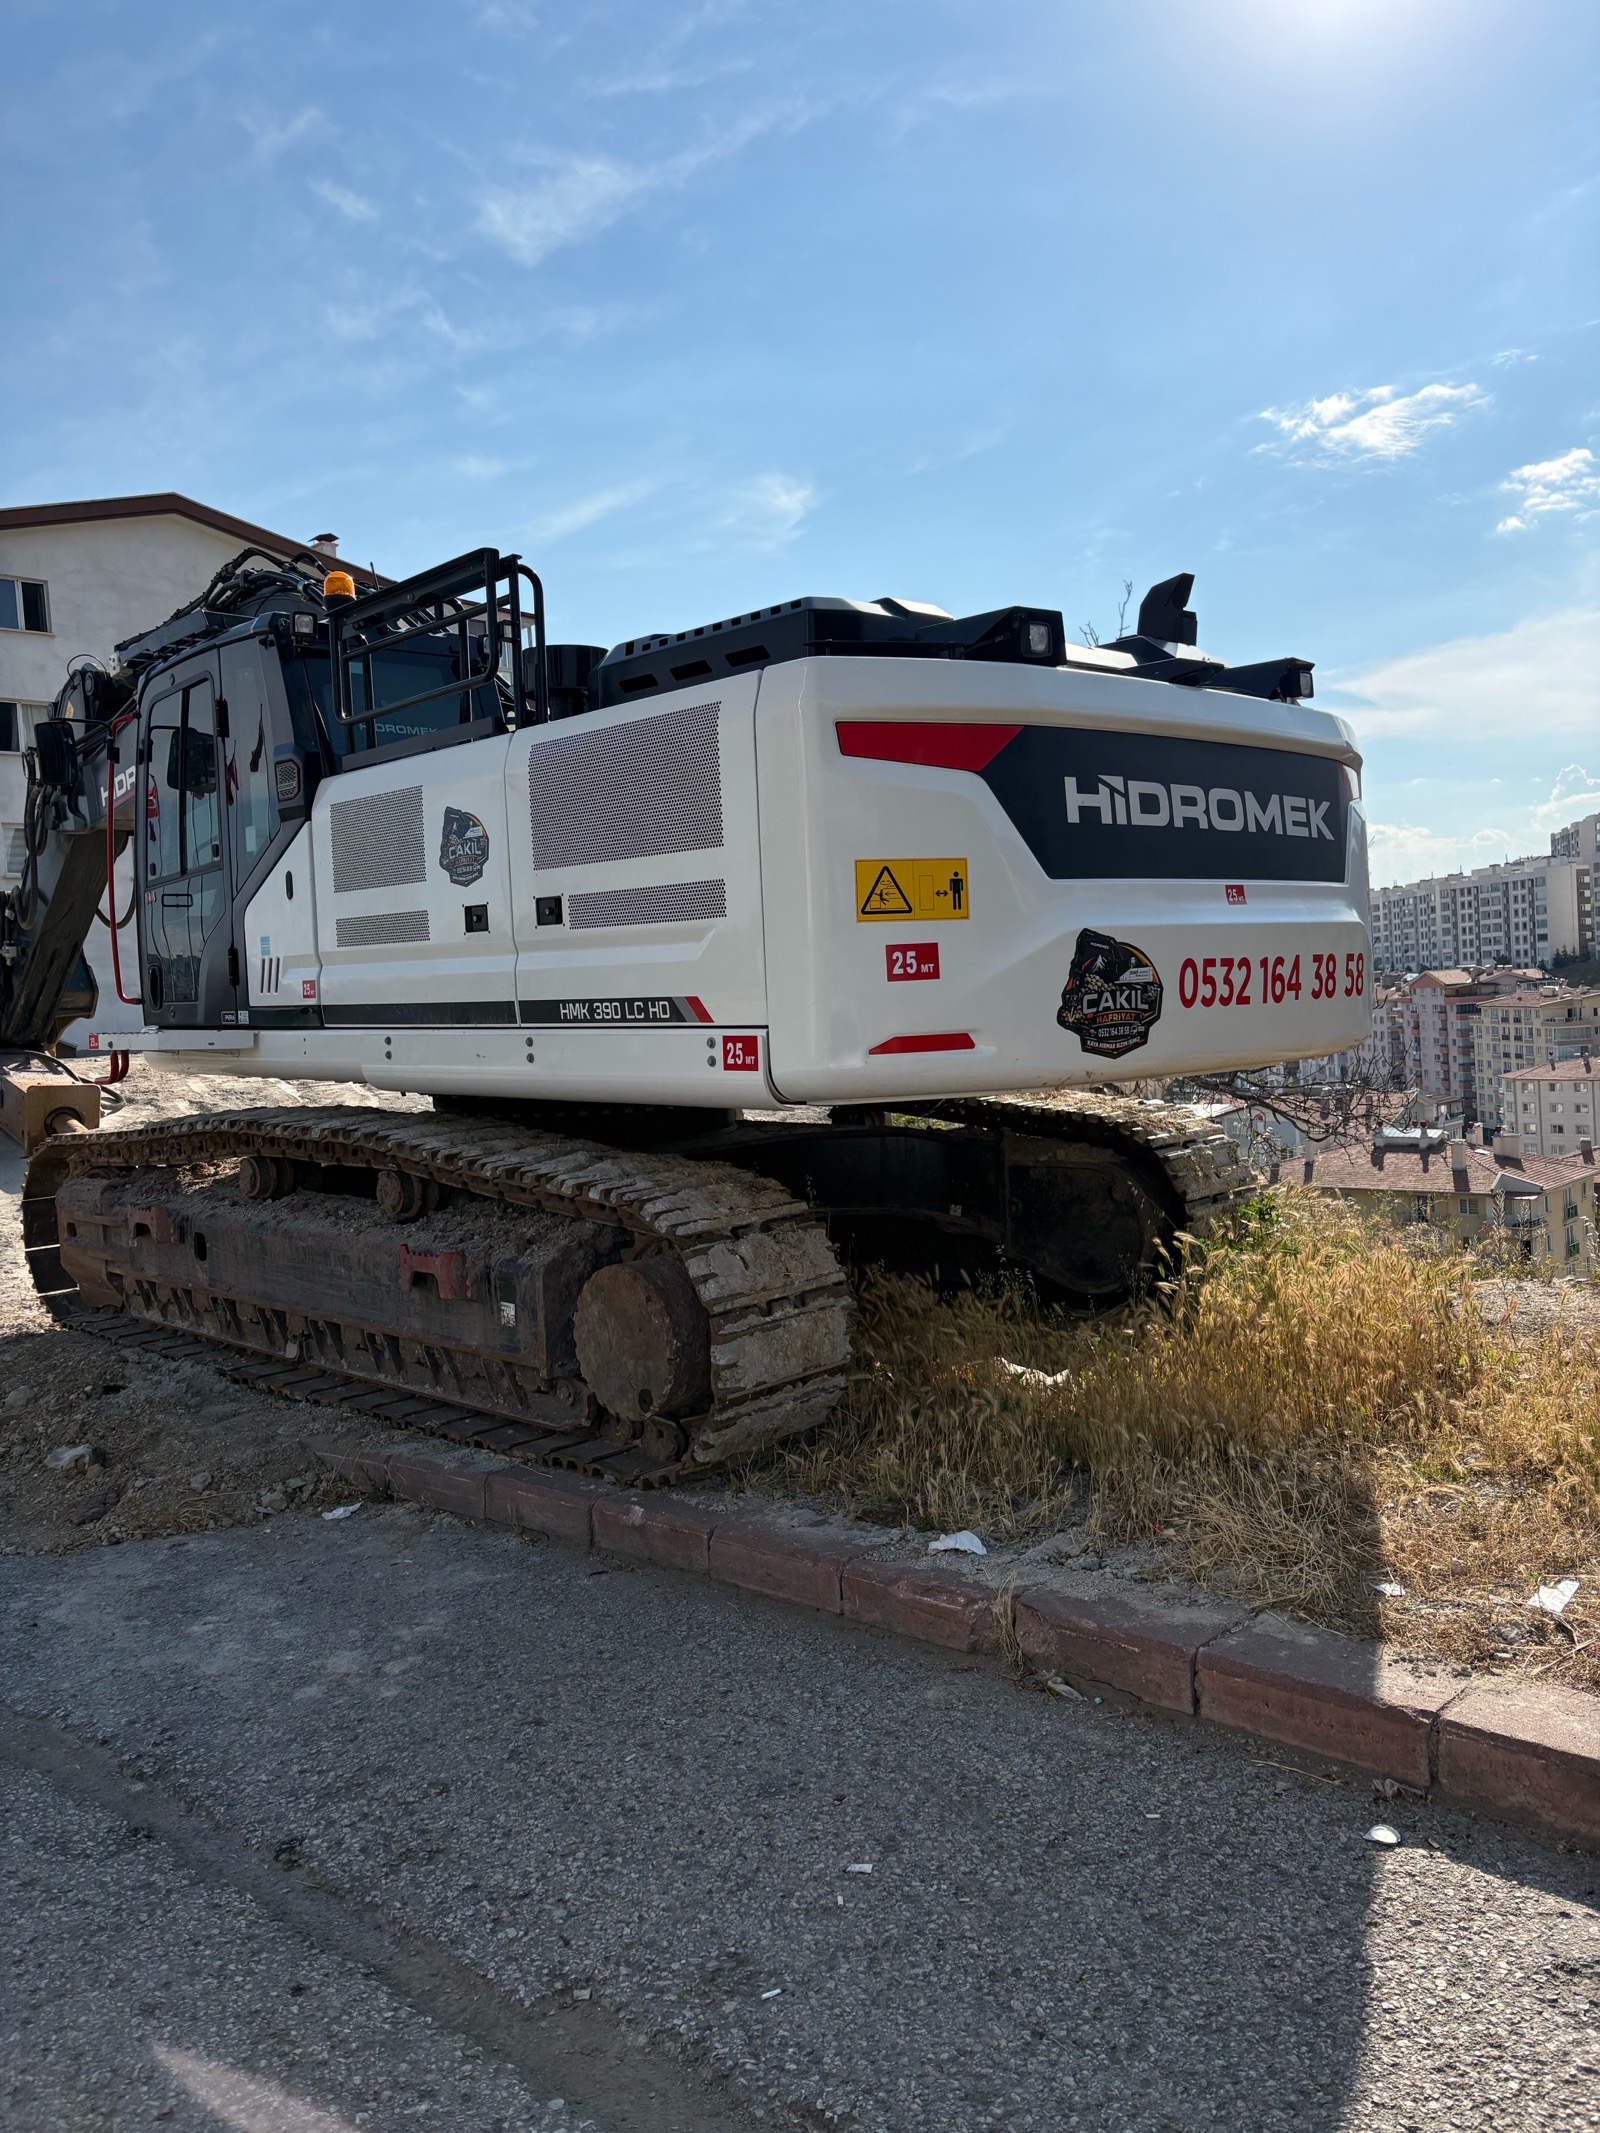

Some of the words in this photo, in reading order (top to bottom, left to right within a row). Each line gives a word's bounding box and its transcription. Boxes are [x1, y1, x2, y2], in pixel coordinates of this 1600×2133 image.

[1227, 889, 1238, 901] 25
[892, 951, 917, 974] 25
[921, 963, 935, 973] MT
[1179, 956, 1251, 1009] 0532
[1259, 954, 1302, 1004] 164
[1311, 953, 1337, 1000] 38
[1344, 953, 1364, 998] 58
[560, 1003, 590, 1020] HMK
[593, 1002, 621, 1019] 390
[624, 1001, 645, 1019] LC
[648, 1001, 671, 1019] HD
[727, 1042, 743, 1065] 25
[745, 1055, 755, 1065] MT
